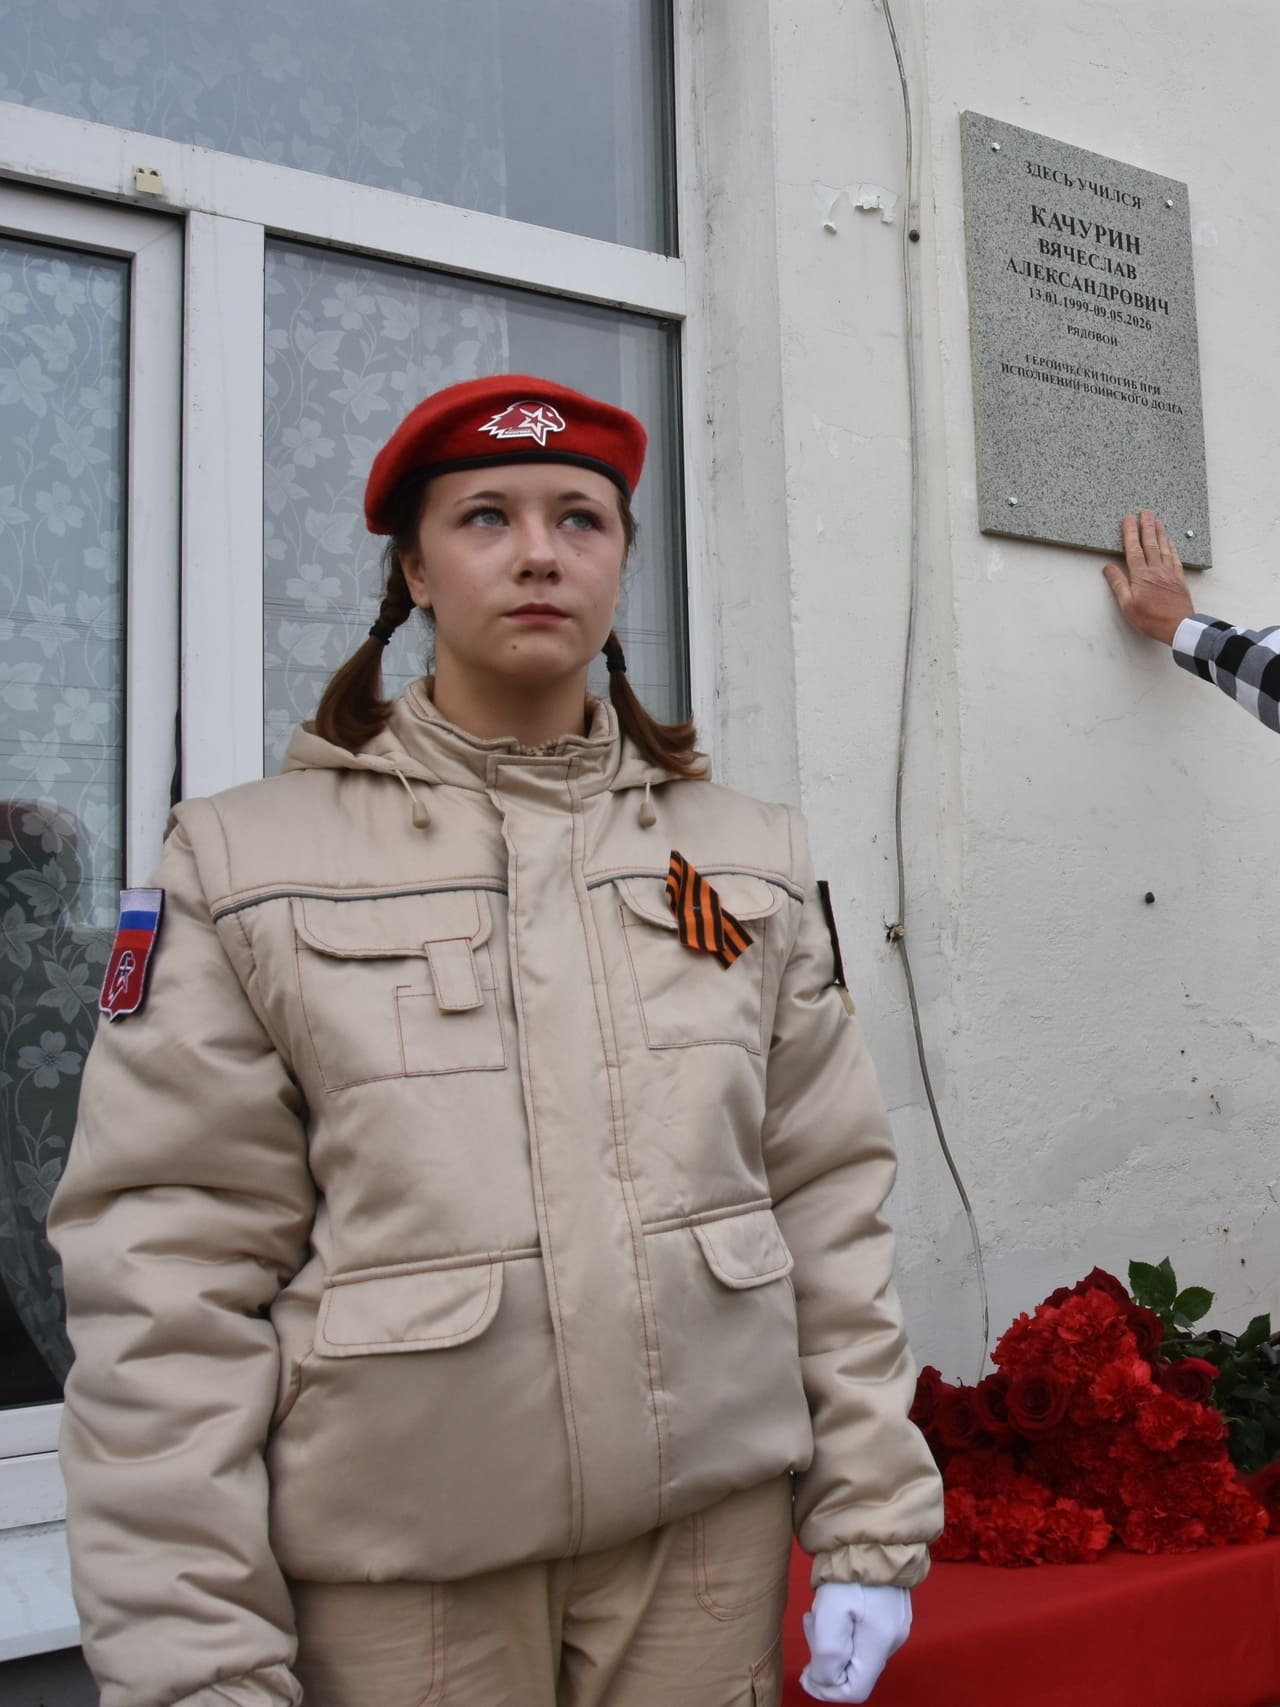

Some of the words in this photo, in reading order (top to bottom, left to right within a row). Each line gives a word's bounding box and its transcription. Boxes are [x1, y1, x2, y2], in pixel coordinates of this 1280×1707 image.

[1024, 160, 1073, 187] ЗДЕСЬ
[1077, 177, 1142, 209] УЧИЛСЯ
[1031, 205, 1141, 255] КАЧУРИН
[1038, 238, 1137, 280] ВЯЧЕСЛАВ
[1006, 257, 1169, 315] АЛЕКСАНДРОВИЧ
[1001, 362, 1080, 391] ИСПОЛНЕНИИ
[1083, 383, 1149, 407] ВОИНСКОГО
[1151, 400, 1184, 416] ДОЛГА
[1025, 353, 1099, 381] ГЕРОИЧЕСКИ
[1101, 372, 1138, 391] ПОГИБ
[1140, 383, 1161, 396] ПРИ
